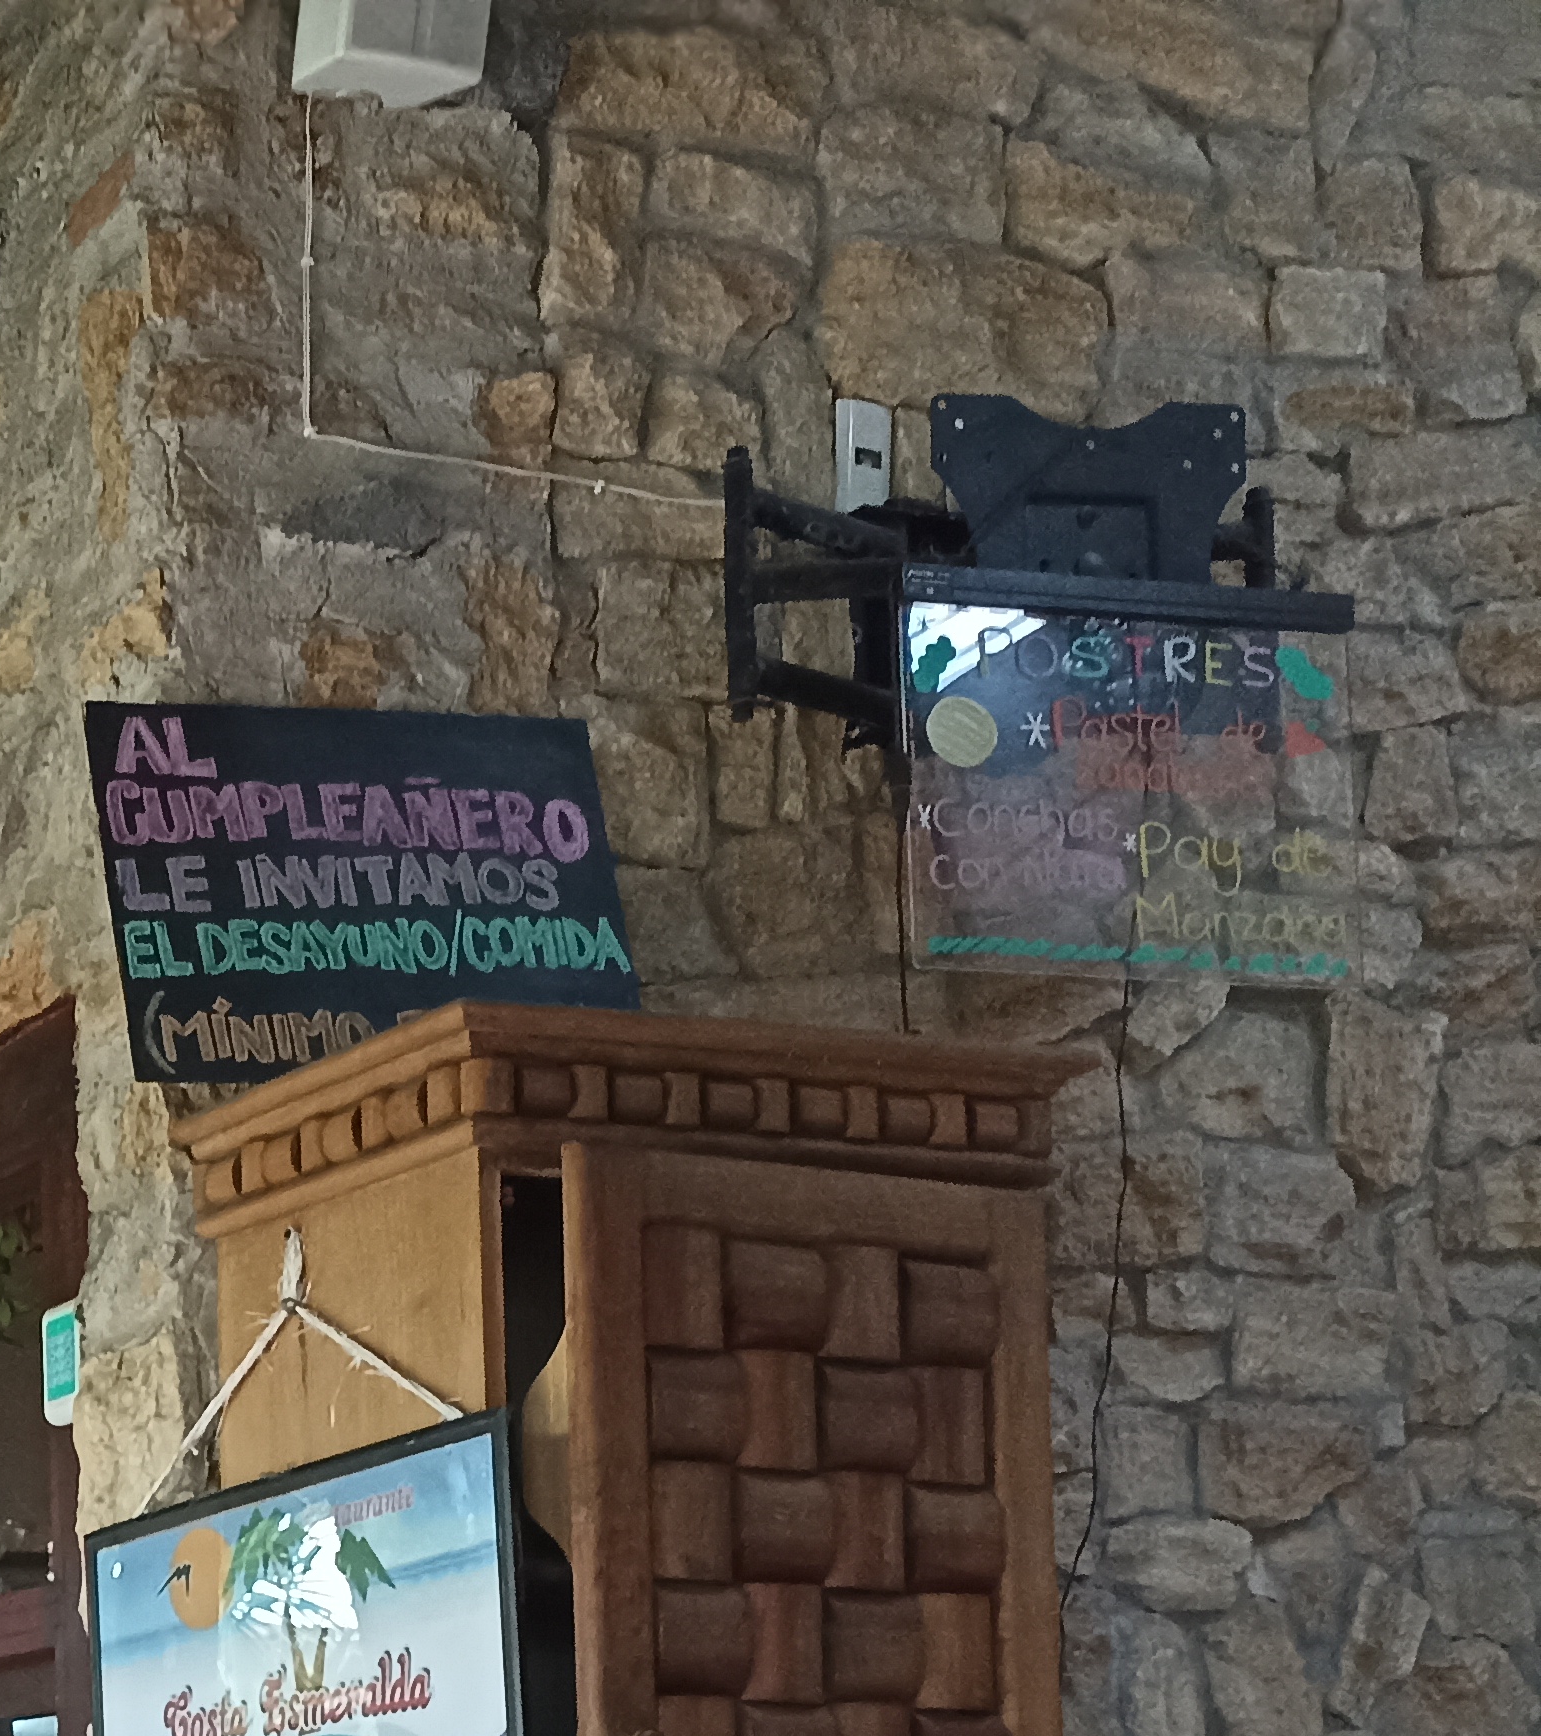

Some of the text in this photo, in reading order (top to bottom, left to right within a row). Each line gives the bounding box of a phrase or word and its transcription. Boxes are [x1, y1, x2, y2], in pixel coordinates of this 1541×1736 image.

[977, 626, 1275, 688] POSTRES
[115, 715, 217, 778] AL
[1051, 697, 1185, 754] Pastel
[105, 776, 590, 863] CUMPLEAÑERO
[116, 853, 560, 913] LE INVITAMOS
[1139, 821, 1242, 897] Pay
[123, 920, 196, 979] EL
